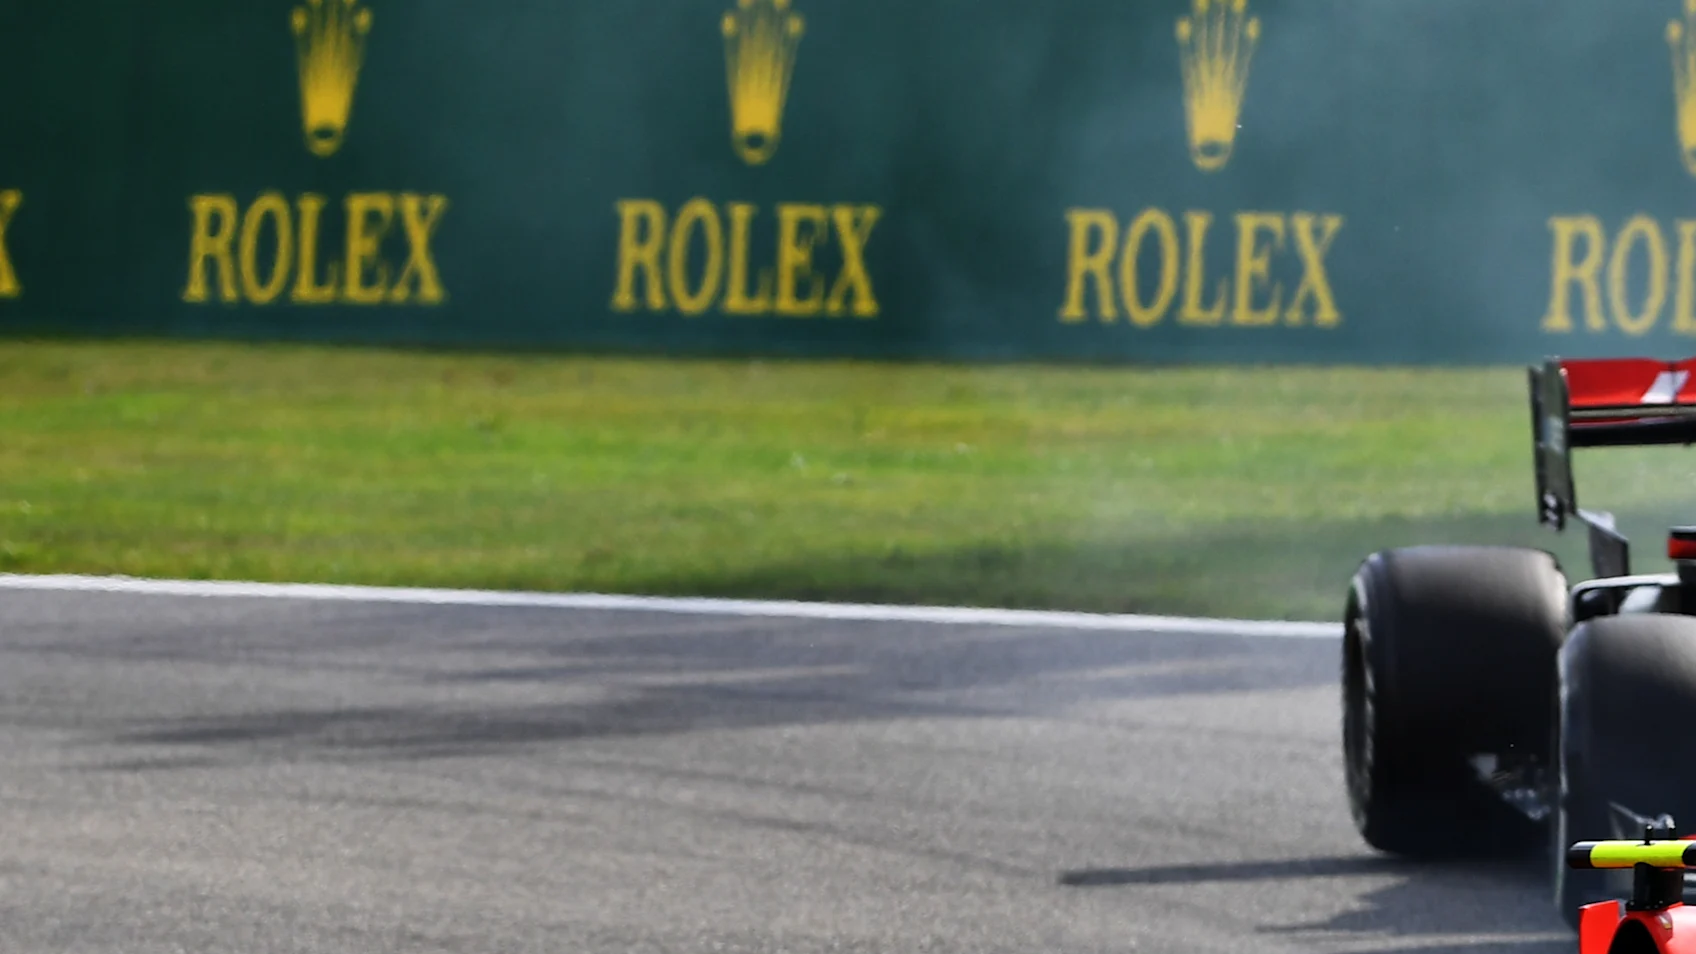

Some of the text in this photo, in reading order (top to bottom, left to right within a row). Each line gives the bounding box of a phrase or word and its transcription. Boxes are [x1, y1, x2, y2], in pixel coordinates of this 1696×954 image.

[186, 193, 446, 304] ROLEX
[612, 198, 880, 316] ROLEX
[1060, 209, 1342, 327] ROLEX
